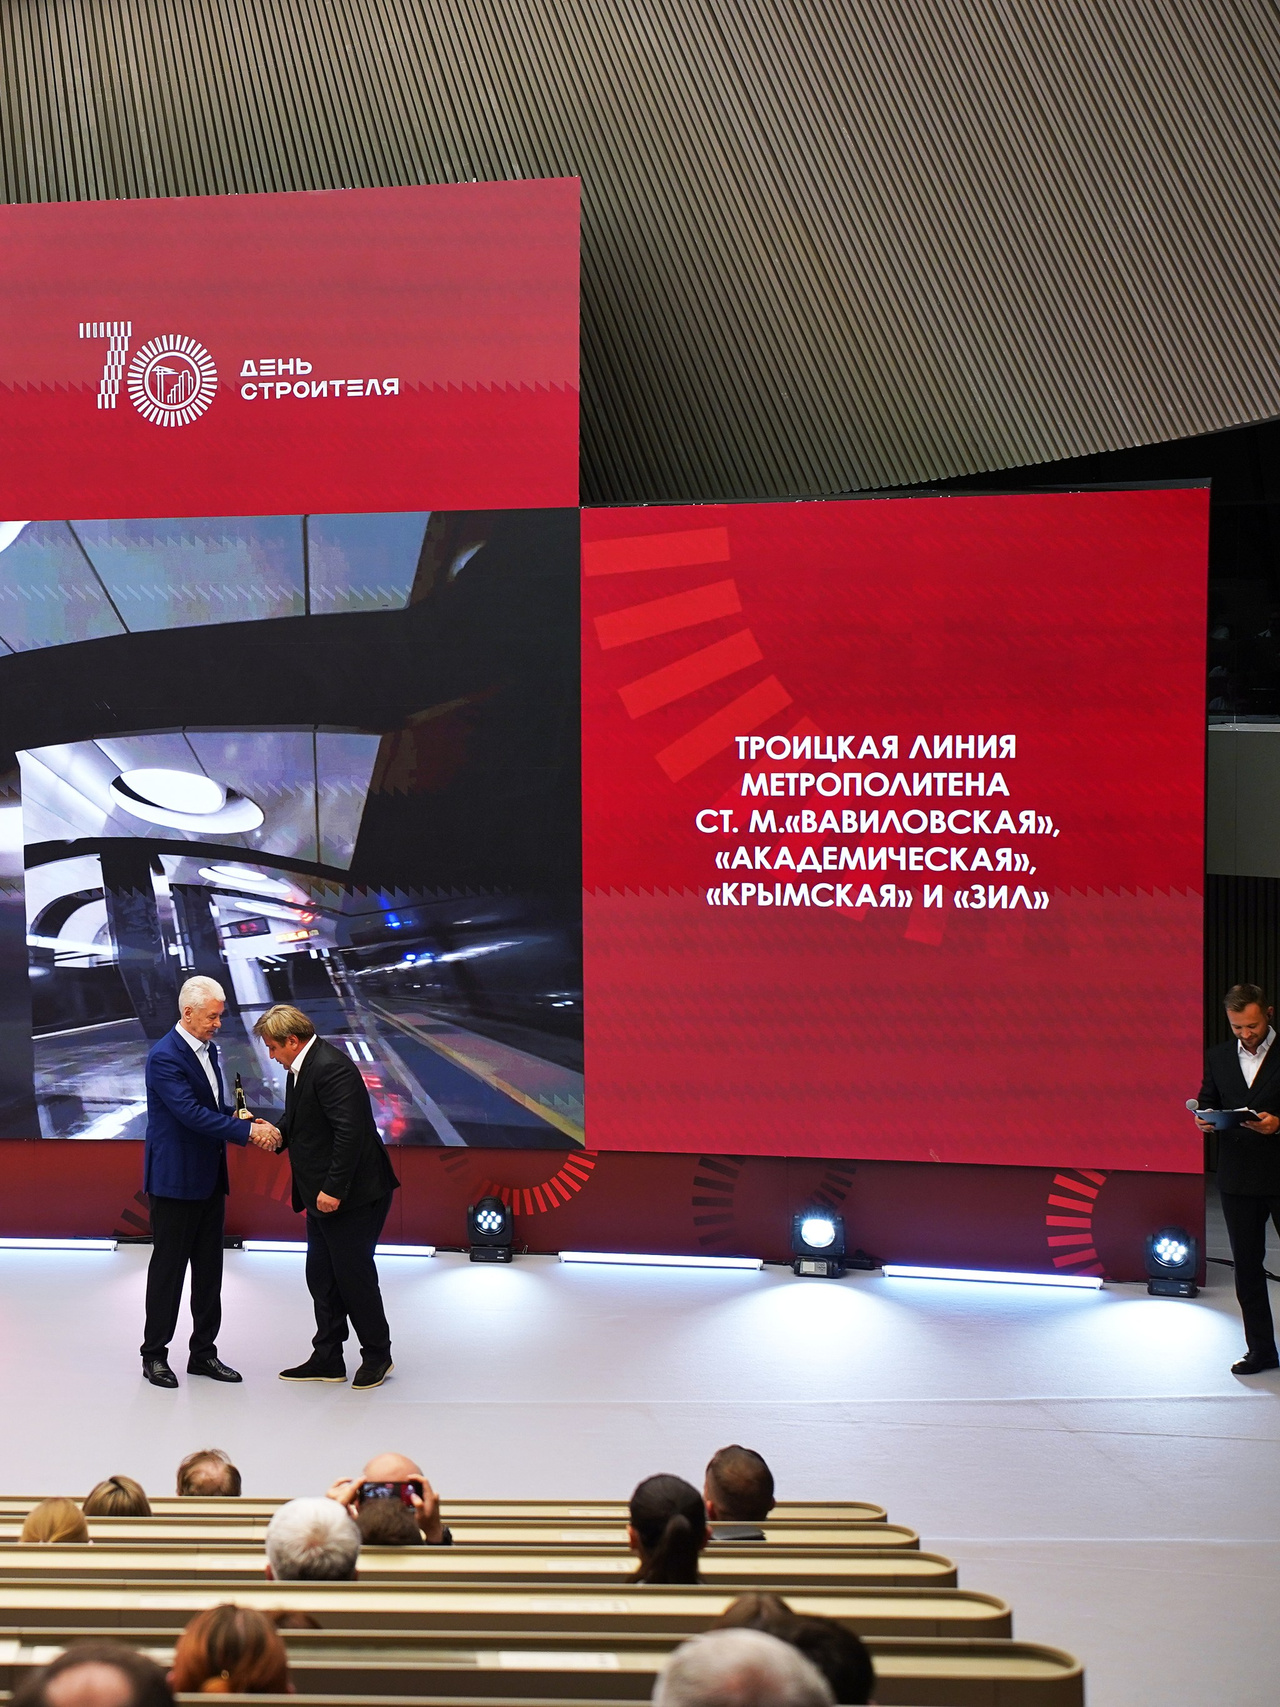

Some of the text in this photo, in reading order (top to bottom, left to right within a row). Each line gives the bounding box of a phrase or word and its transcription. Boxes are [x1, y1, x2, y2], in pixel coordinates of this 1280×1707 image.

[78, 320, 218, 428] 70
[239, 357, 313, 377] ДЕНЬ
[240, 377, 399, 401] СТРОИТЕЛЯ
[734, 734, 1017, 763] ТРОИЦКАЯ ЛИНИЯ
[740, 771, 1011, 797] МЕТРОПОЛИТЕНА
[695, 808, 739, 834] СТ.
[715, 845, 1037, 875] «АКАДЕМИЧЕСКАЯ»,
[706, 882, 1050, 910] «КРЫМСКАЯ» И «ЗИЛ»
